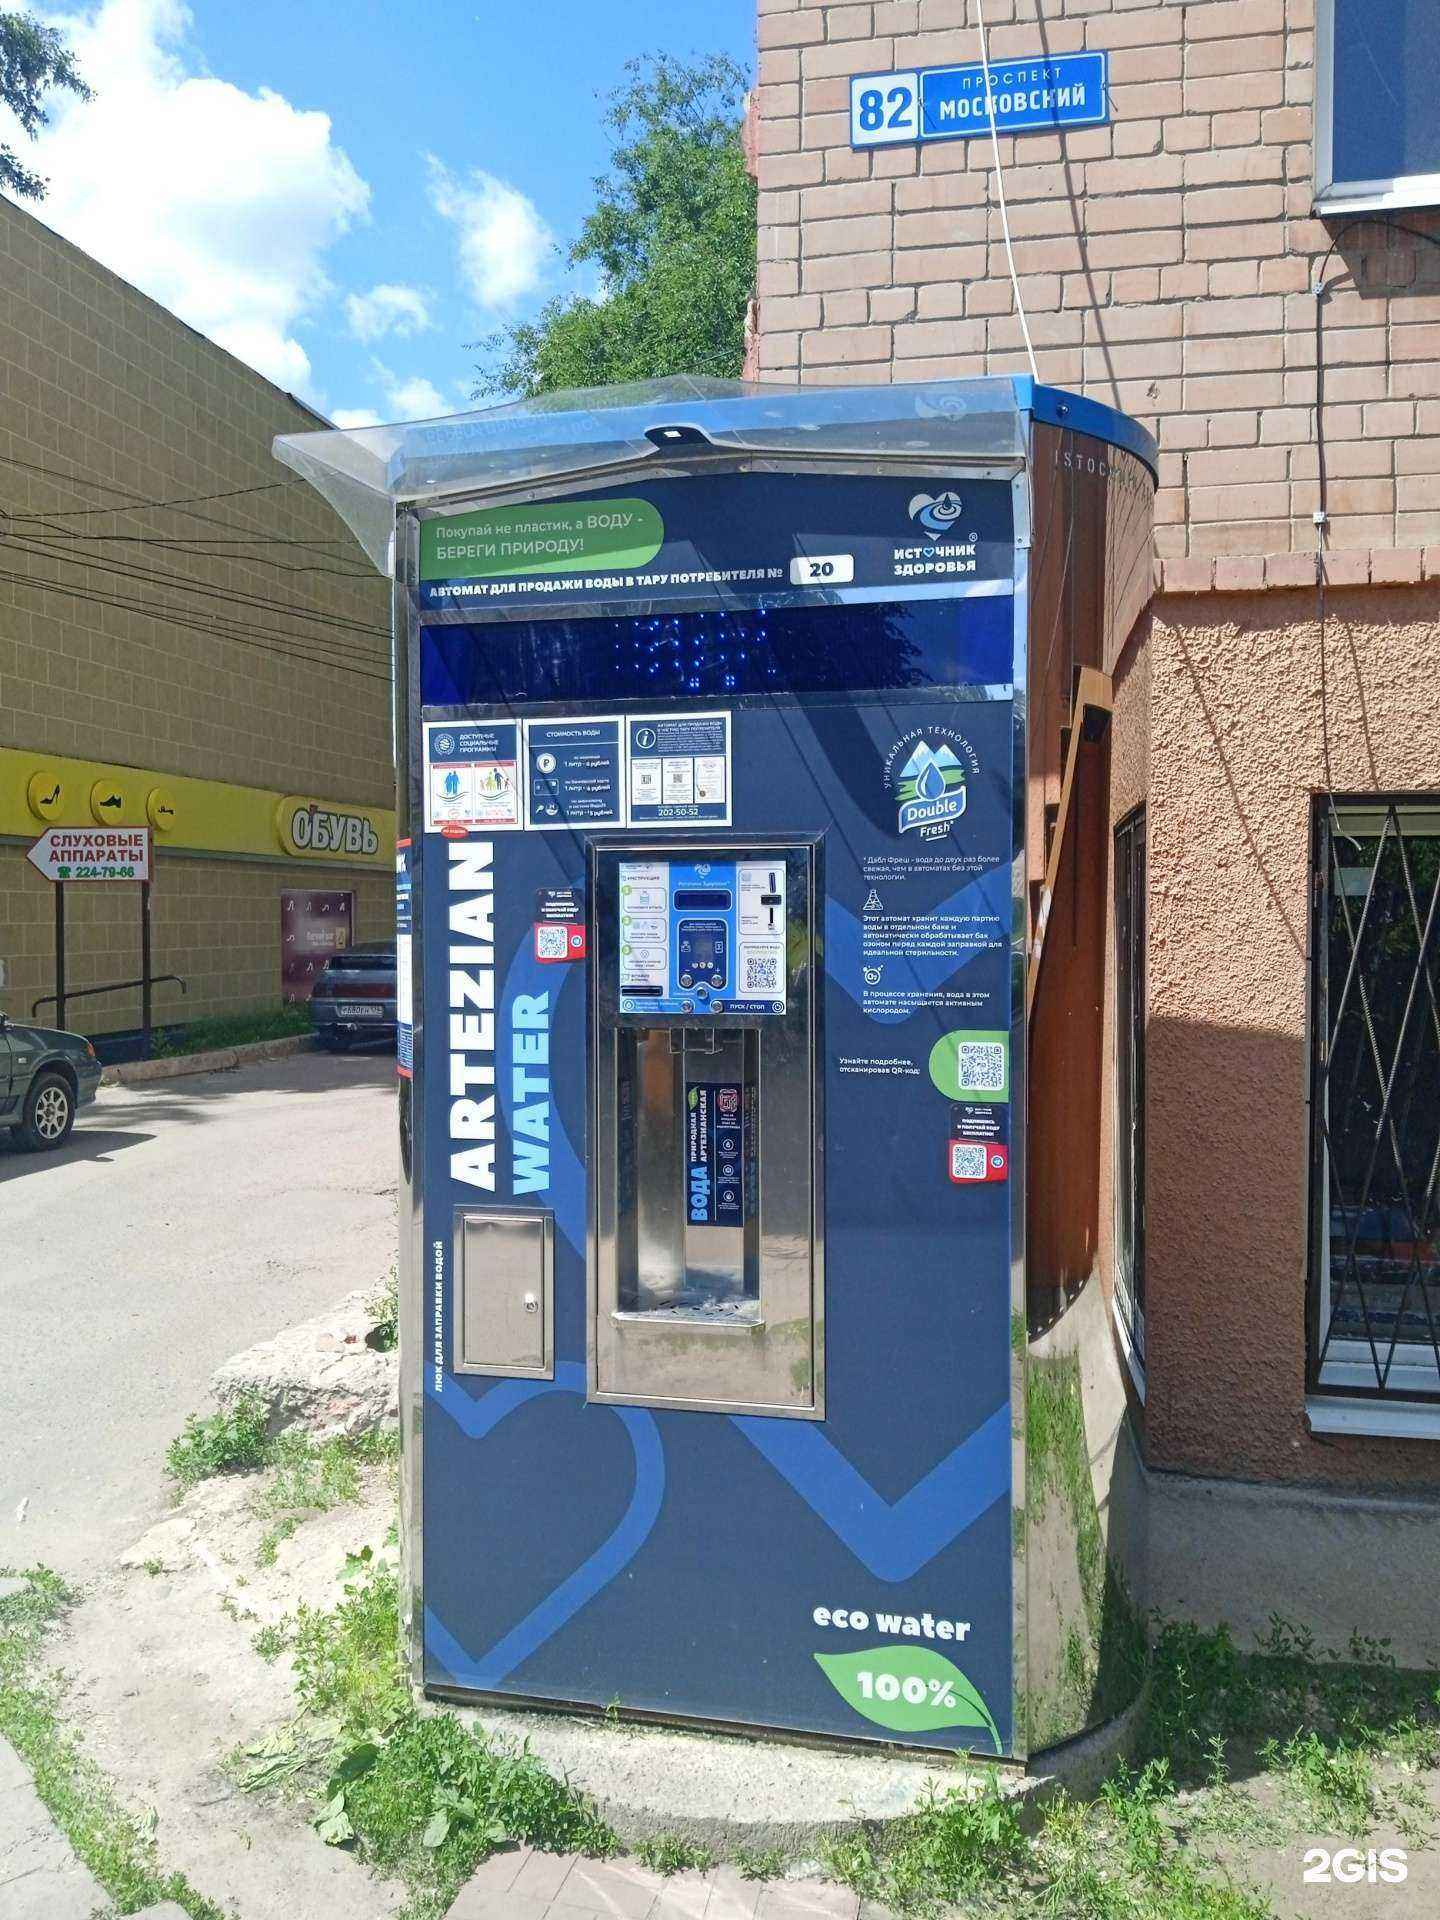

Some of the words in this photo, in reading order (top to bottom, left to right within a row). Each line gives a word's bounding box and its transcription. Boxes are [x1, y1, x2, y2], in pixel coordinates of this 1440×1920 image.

[962, 67, 1062, 89] ПРОСПЕКТ
[860, 87, 912, 130] 82
[940, 83, 1086, 120] МОСКОВСКИЙ
[436, 522, 492, 539] Покупай
[496, 522, 511, 535] не
[515, 519, 572, 534] пластик,
[576, 521, 583, 530] а
[587, 513, 632, 530] ВОДУ
[437, 545, 496, 560] БЕРЕГИ
[500, 538, 584, 557] ПРИРОДУ!
[430, 584, 487, 598] АВТОМАТ
[490, 583, 516, 596] ДЛЯ
[518, 579, 583, 592] ПРОДАЖИ
[585, 578, 624, 590] ВОДЫ
[626, 576, 634, 587] В
[636, 574, 668, 587] ТАРУ
[670, 568, 764, 583] ПОТРЕБИТЕЛЯ
[810, 562, 834, 578] 20
[894, 559, 976, 577] ЗДОРОВЬЯ
[883, 728, 922, 789] УНИКАЛЬНАЯ
[928, 726, 980, 774] ТЕХНОЛОГИЯ
[907, 800, 958, 821] Double
[50, 834, 144, 848] СЛУХОВЫЕ
[292, 808, 378, 854] ОБУВЬ
[49, 850, 143, 862] АППАРАТЫ
[448, 842, 496, 1192] ARTEZIAN
[839, 1057, 869, 1065] Узнайте
[512, 990, 550, 1195] WATER
[700, 1089, 708, 1162] АРТЕЗИАНСКАЯ
[690, 1166, 710, 1221] ВОДА
[432, 1241, 444, 1280] ВОДОЙ
[434, 1283, 443, 1341] ЗАПРАВКИ
[434, 1342, 444, 1364] ДЛЯ
[434, 1366, 442, 1392] ЛЮК
[812, 1606, 870, 1630] eco
[876, 1613, 971, 1642] water
[856, 1672, 956, 1708] 100%
